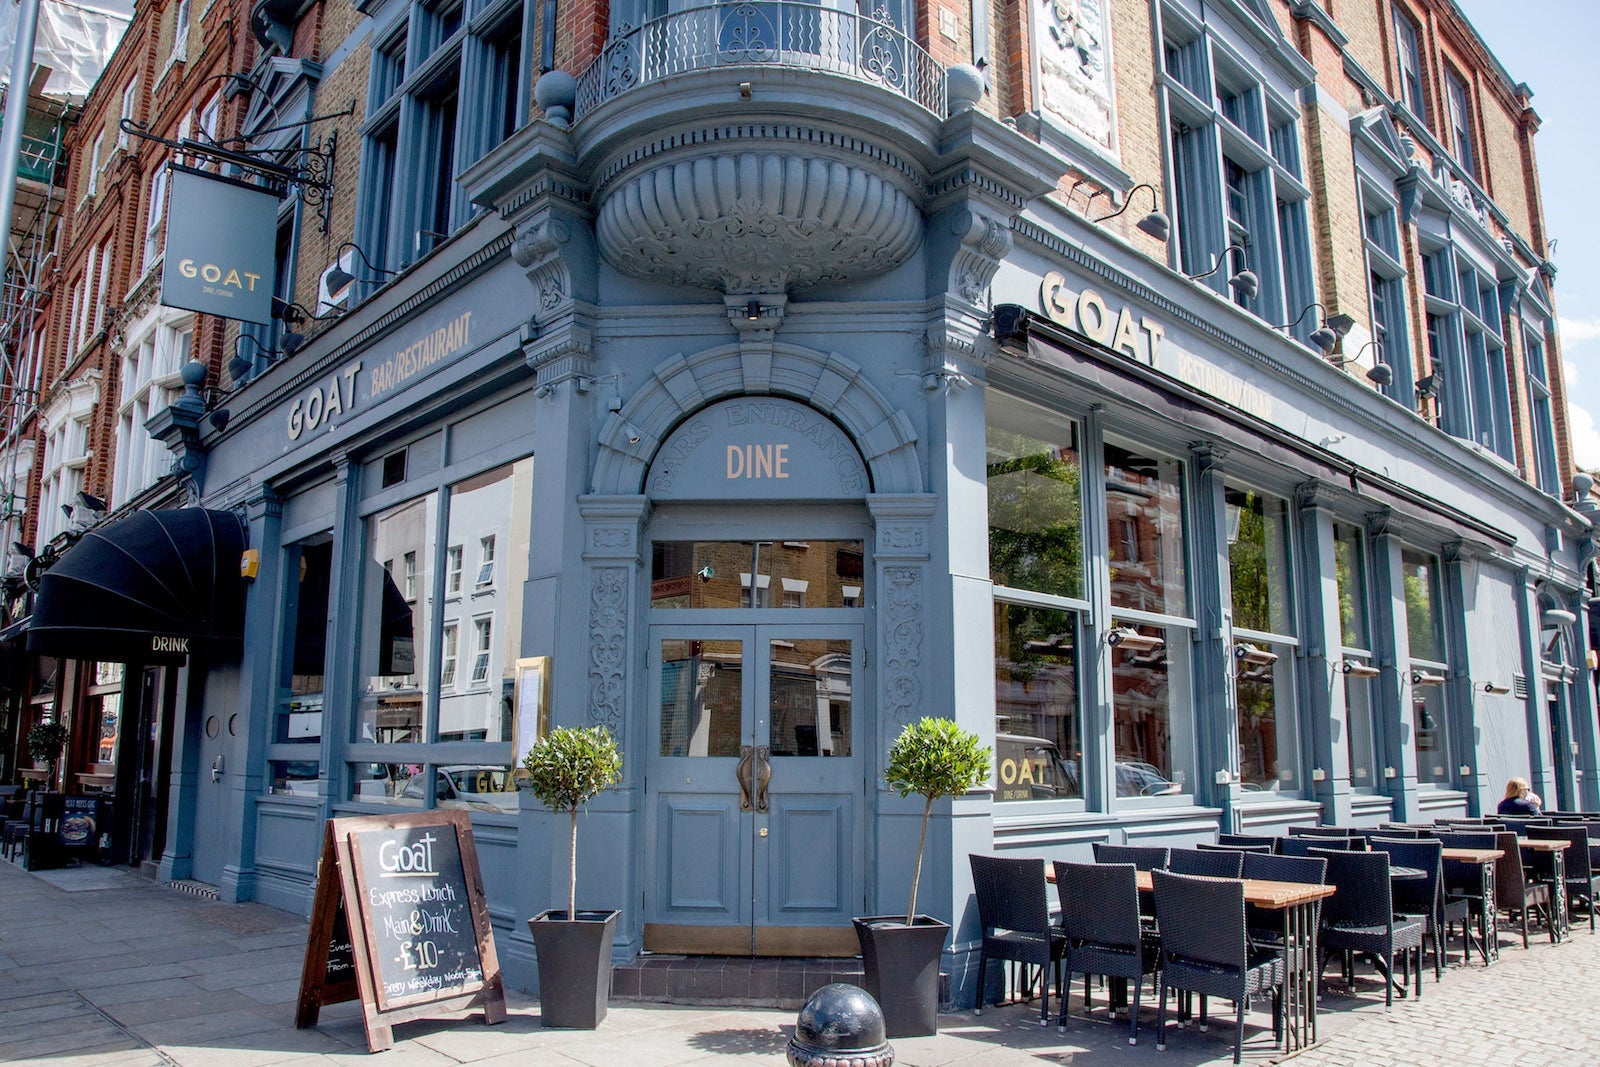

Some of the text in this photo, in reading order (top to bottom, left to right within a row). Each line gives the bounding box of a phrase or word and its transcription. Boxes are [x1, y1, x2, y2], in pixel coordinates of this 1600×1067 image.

[178, 258, 261, 292] GOAT
[1041, 270, 1165, 370] GOAT
[371, 310, 473, 397] BAR/RESTAURANT
[287, 360, 363, 441] GOAT
[725, 403, 864, 496] ENTRANCE
[726, 444, 789, 479] DINE
[152, 635, 190, 652] DRINK
[475, 770, 517, 794] GOA
[1000, 758, 1048, 785] OAT
[379, 832, 437, 872] Goat
[370, 883, 456, 908] Express Lunch
[384, 915, 411, 940] Main
[410, 909, 425, 935] &
